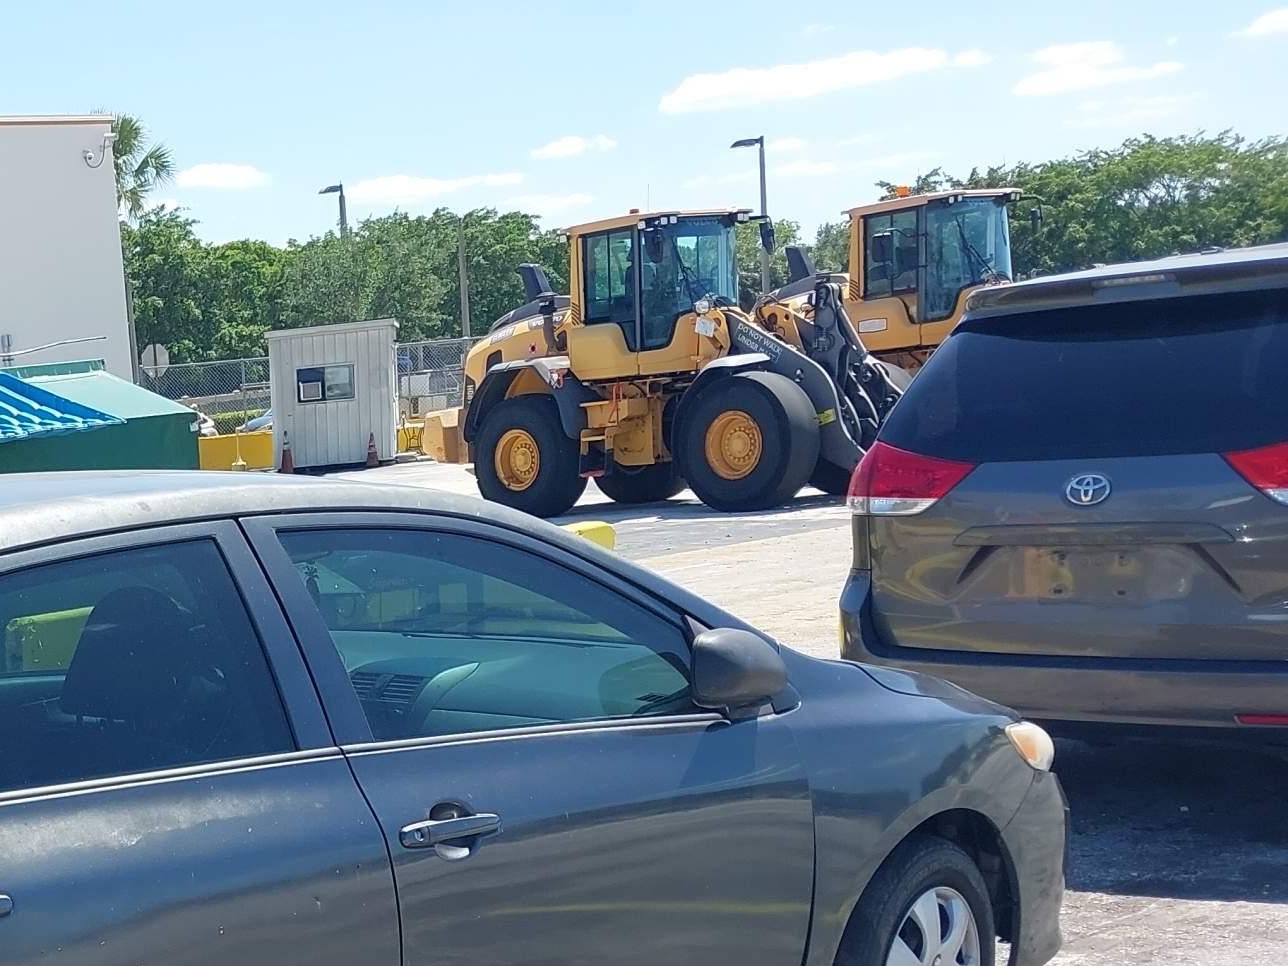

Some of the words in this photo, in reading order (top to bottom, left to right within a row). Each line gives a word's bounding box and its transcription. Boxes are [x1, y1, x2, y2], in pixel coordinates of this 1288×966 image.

[532, 316, 563, 327] VOVO
[737, 322, 748, 333] DO
[749, 330, 763, 342] NOT
[763, 338, 783, 354] WALK
[737, 334, 759, 352] UNDER
